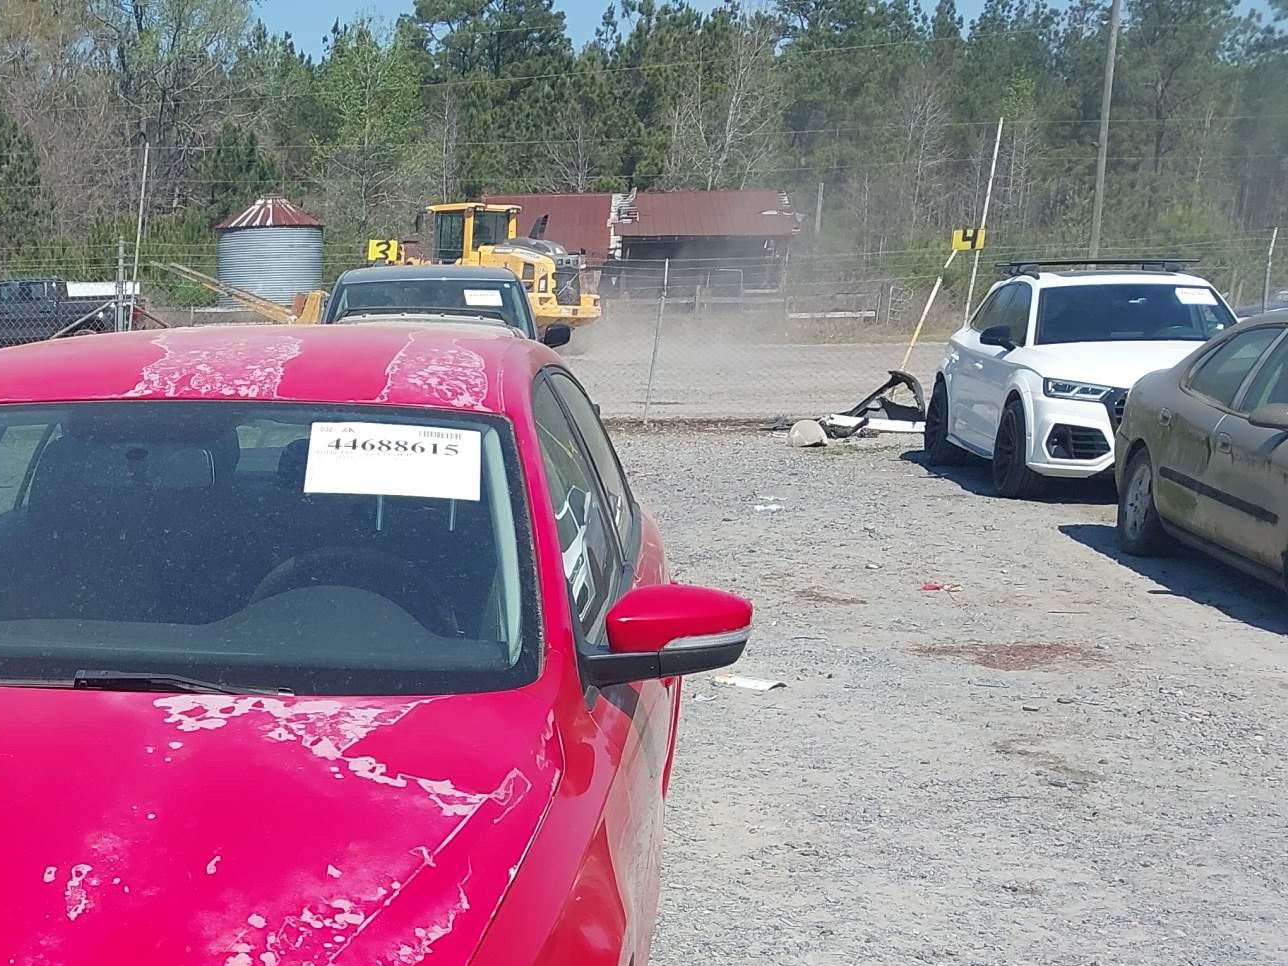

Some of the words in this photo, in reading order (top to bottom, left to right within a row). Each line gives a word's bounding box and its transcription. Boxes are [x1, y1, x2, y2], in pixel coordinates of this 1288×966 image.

[962, 228, 979, 249] 4
[377, 240, 391, 260] 3
[326, 437, 460, 458] 44688615
